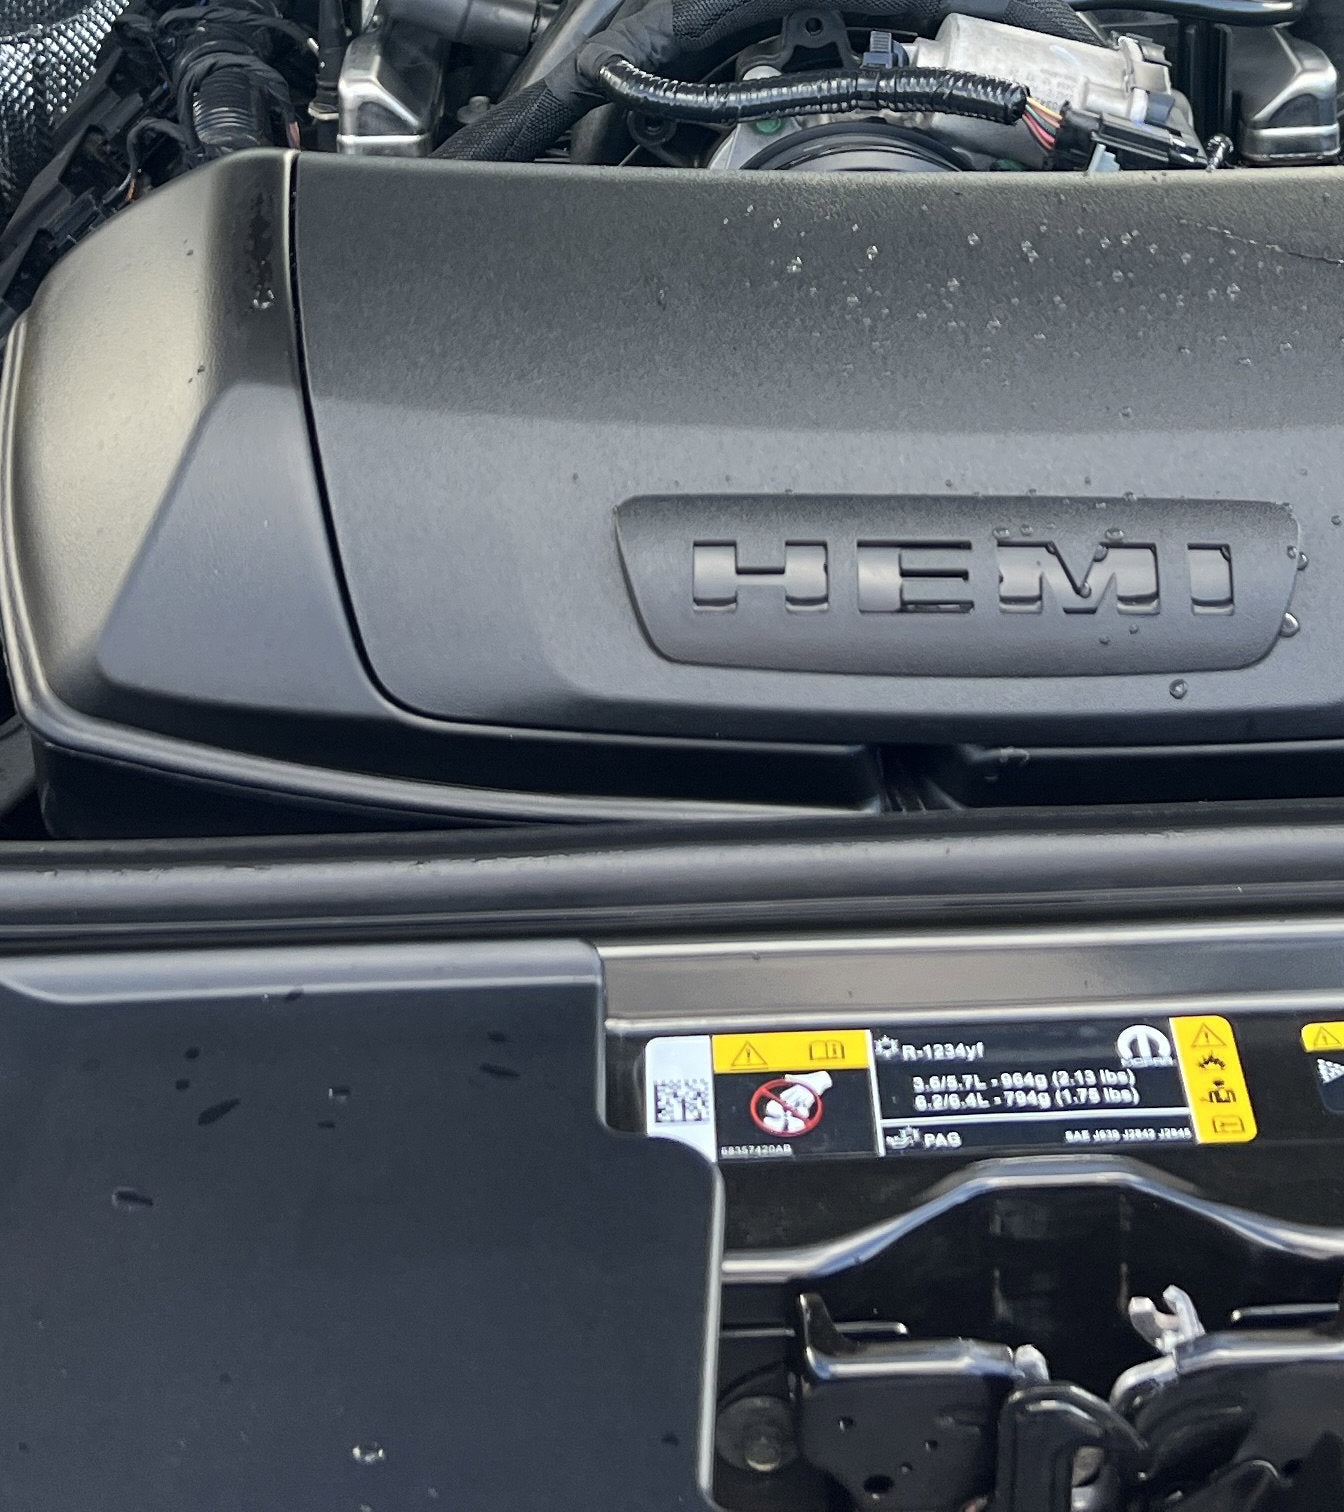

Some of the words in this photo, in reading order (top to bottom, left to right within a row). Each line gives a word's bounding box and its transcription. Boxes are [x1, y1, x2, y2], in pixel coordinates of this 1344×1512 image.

[692, 540, 1234, 614] HEMI
[902, 1041, 985, 1062] R-1234yf
[913, 1074, 987, 1093] 3.6/5.7L
[1000, 1071, 1048, 1090] 964g
[1052, 1070, 1097, 1089] (2.13
[1099, 1068, 1136, 1087] lbs)
[914, 1092, 990, 1112] 6.2/6.4L
[1003, 1090, 1052, 1110] 794g
[1055, 1088, 1101, 1108] (1.75
[1103, 1086, 1140, 1106] lbs)
[924, 1131, 963, 1148] PAG
